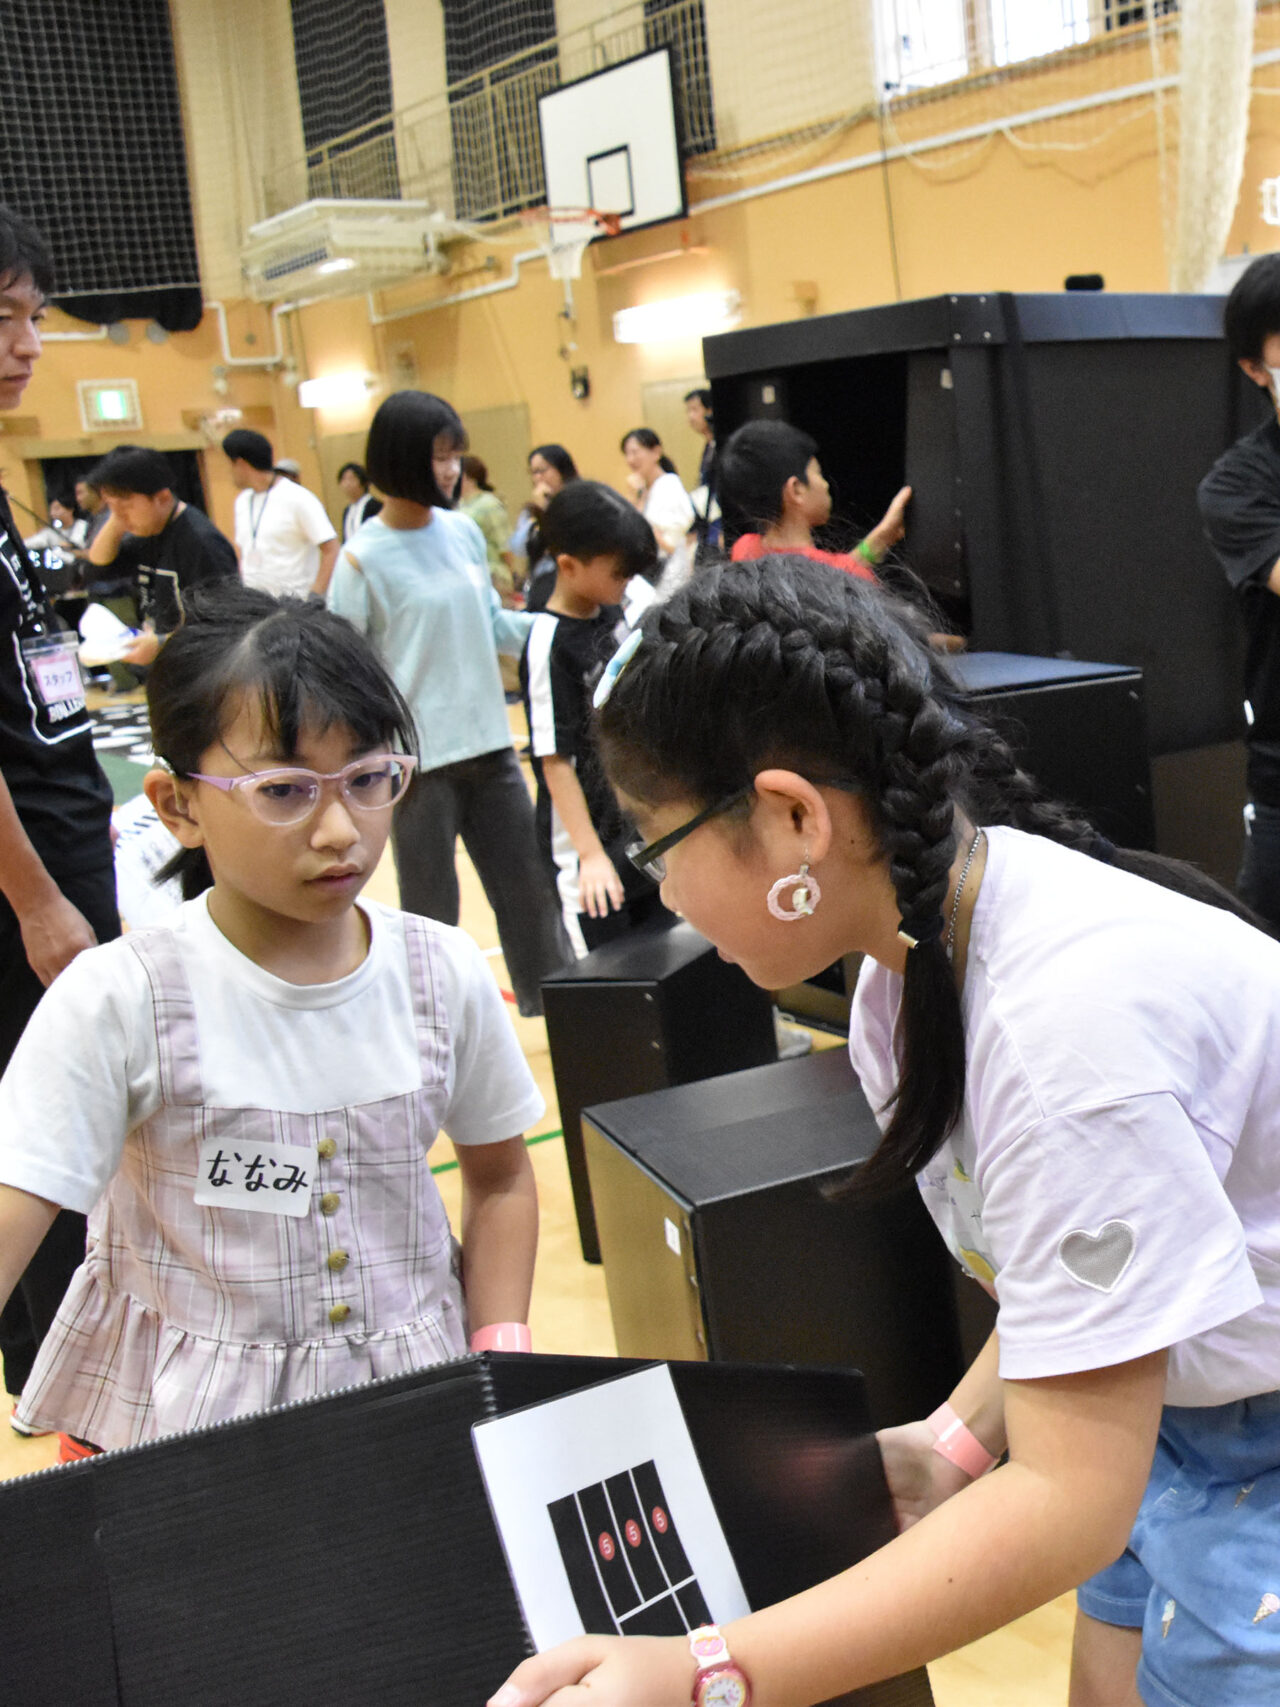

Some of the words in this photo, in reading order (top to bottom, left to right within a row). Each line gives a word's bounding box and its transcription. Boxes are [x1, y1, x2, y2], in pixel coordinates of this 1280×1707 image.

[43, 671, 73, 687] スタッフ
[206, 1150, 309, 1193] ななみ
[602, 1538, 611, 1555] 5
[629, 1525, 638, 1542] 5
[656, 1512, 665, 1528] 5
